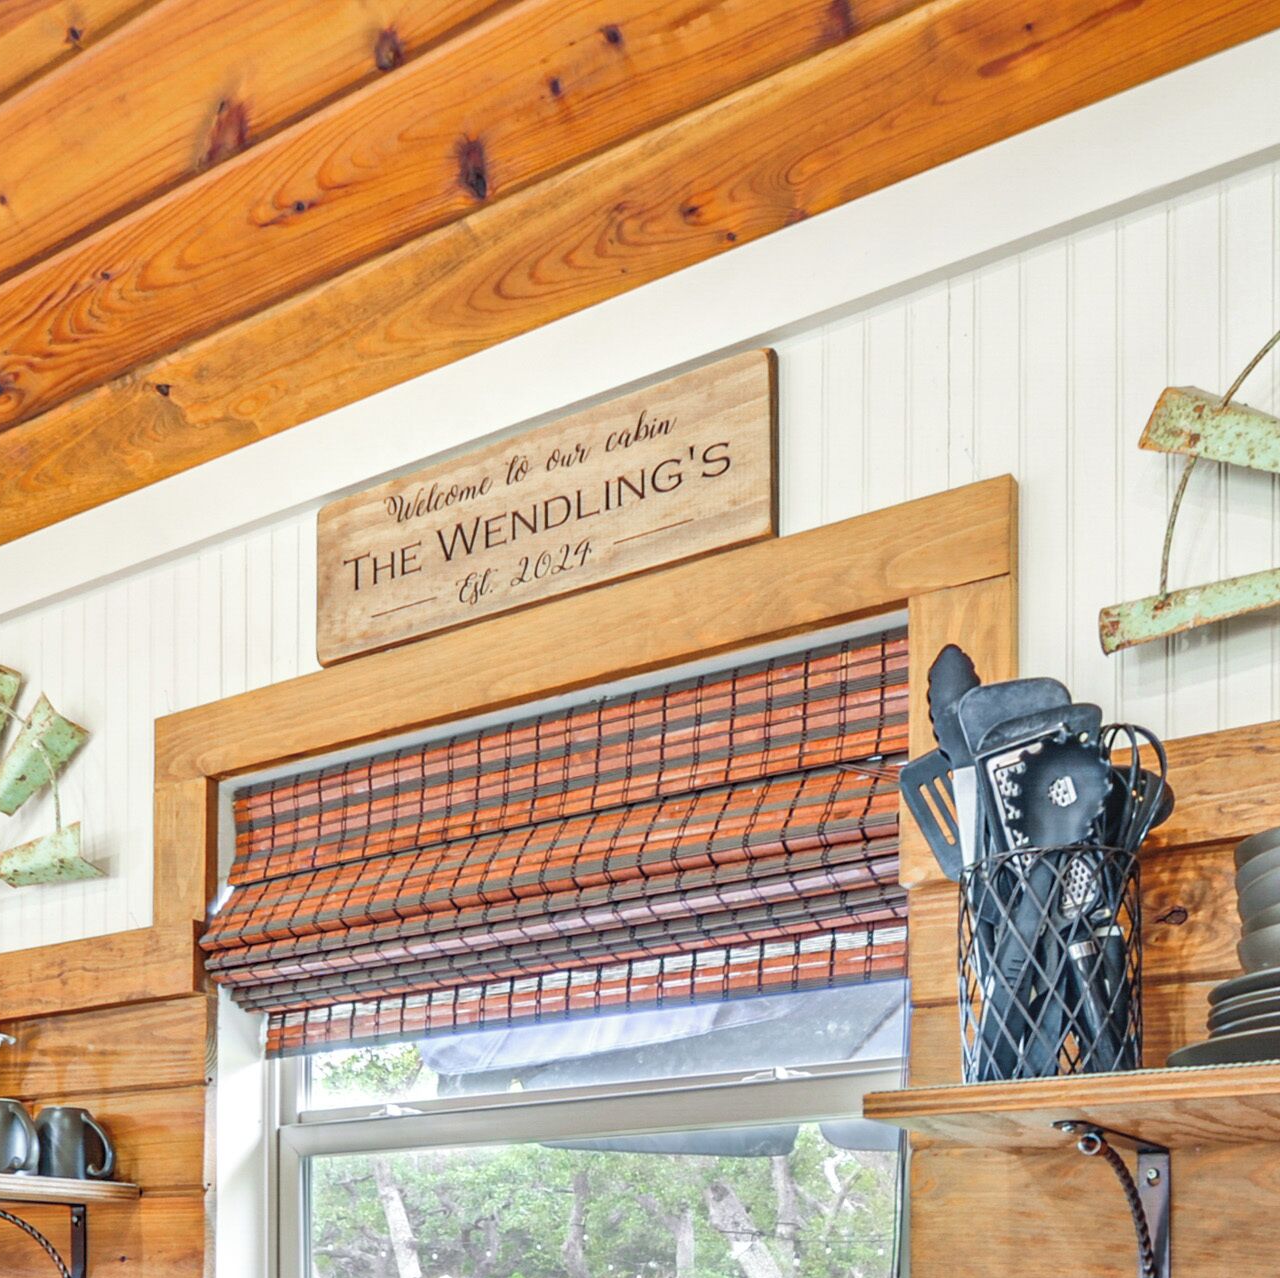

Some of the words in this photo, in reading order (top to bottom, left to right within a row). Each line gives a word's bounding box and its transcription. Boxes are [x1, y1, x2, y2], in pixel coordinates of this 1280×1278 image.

[343, 540, 423, 592] THE
[436, 440, 733, 562] WENDLING'S
[383, 475, 493, 524] Welcome
[505, 454, 533, 486] to
[545, 441, 593, 473] our
[605, 409, 679, 452] cabin
[455, 570, 497, 606] Est.
[509, 537, 594, 588] 2024
